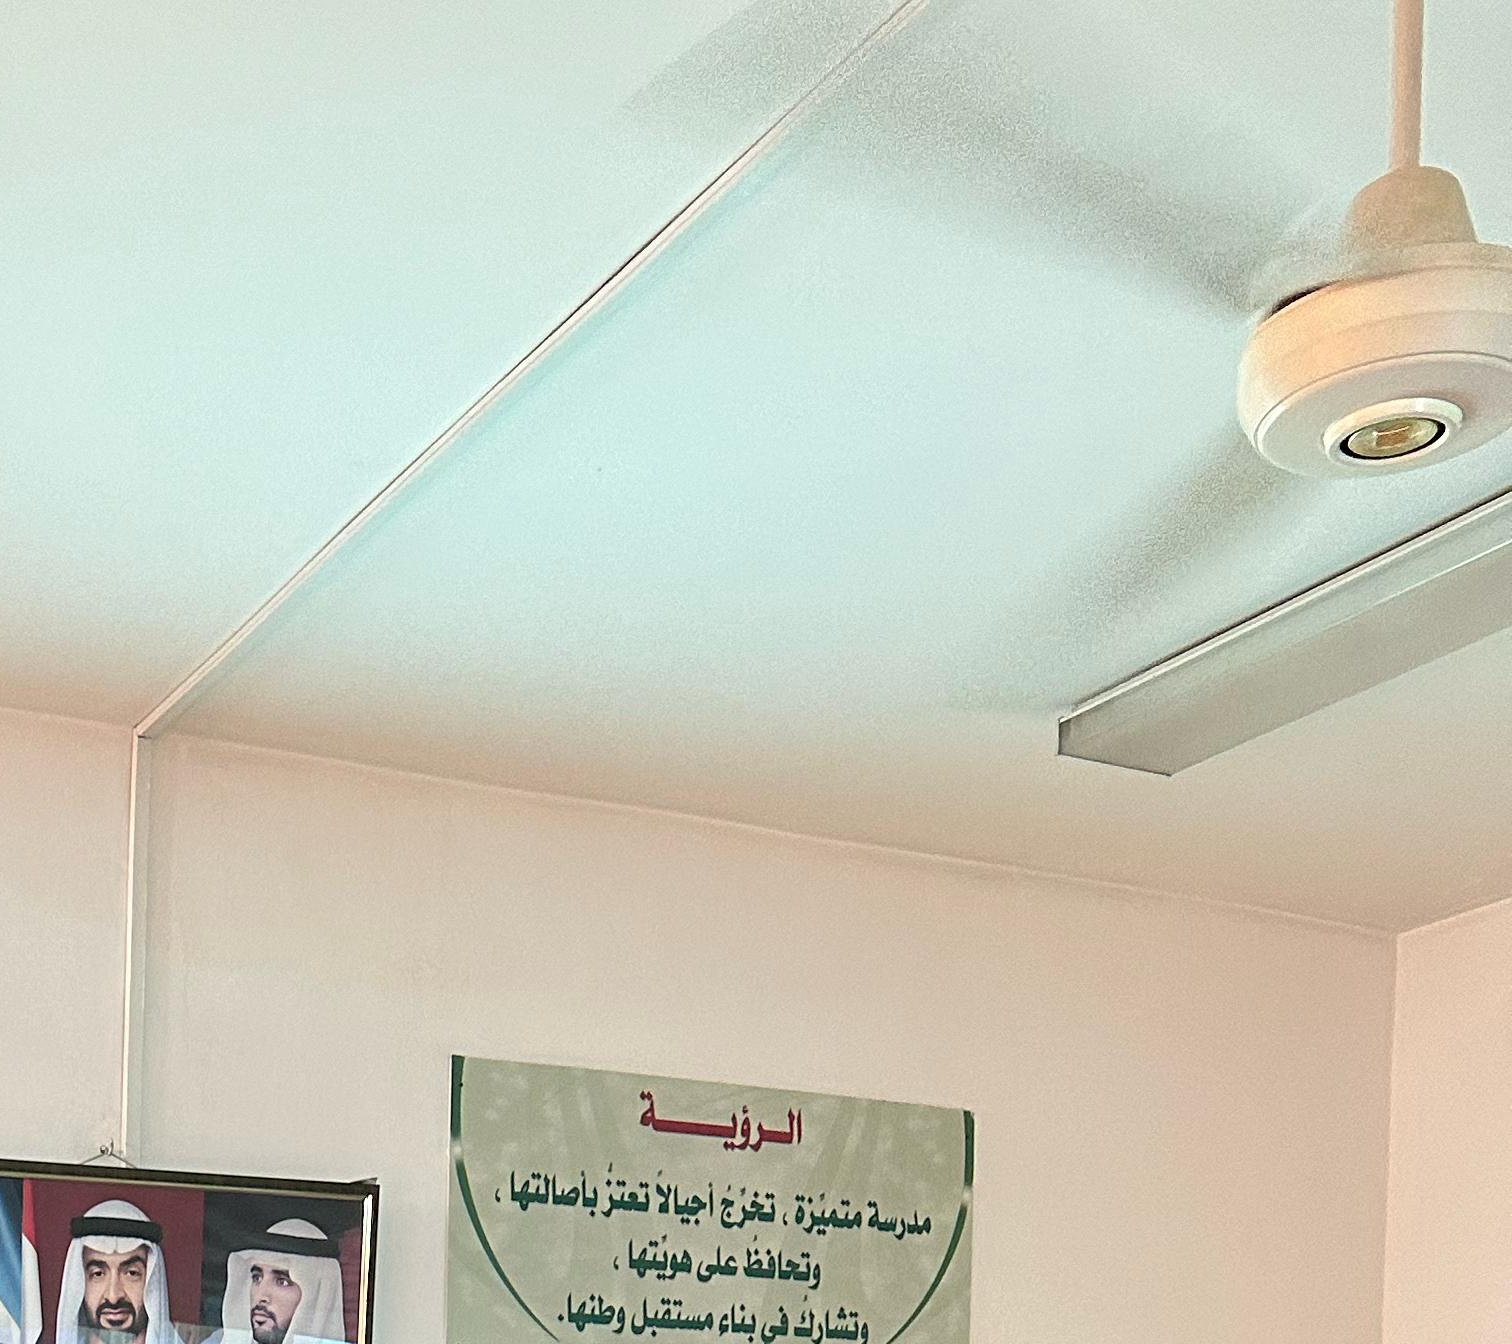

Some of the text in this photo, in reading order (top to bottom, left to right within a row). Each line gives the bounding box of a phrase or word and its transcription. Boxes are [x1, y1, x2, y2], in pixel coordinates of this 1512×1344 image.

[639, 1090, 802, 1152] الرؤية
[867, 1200, 932, 1241] مدرسة
[697, 1246, 738, 1282] على
[631, 1296, 714, 1337] مستقبل
[719, 1303, 756, 1343] بناء
